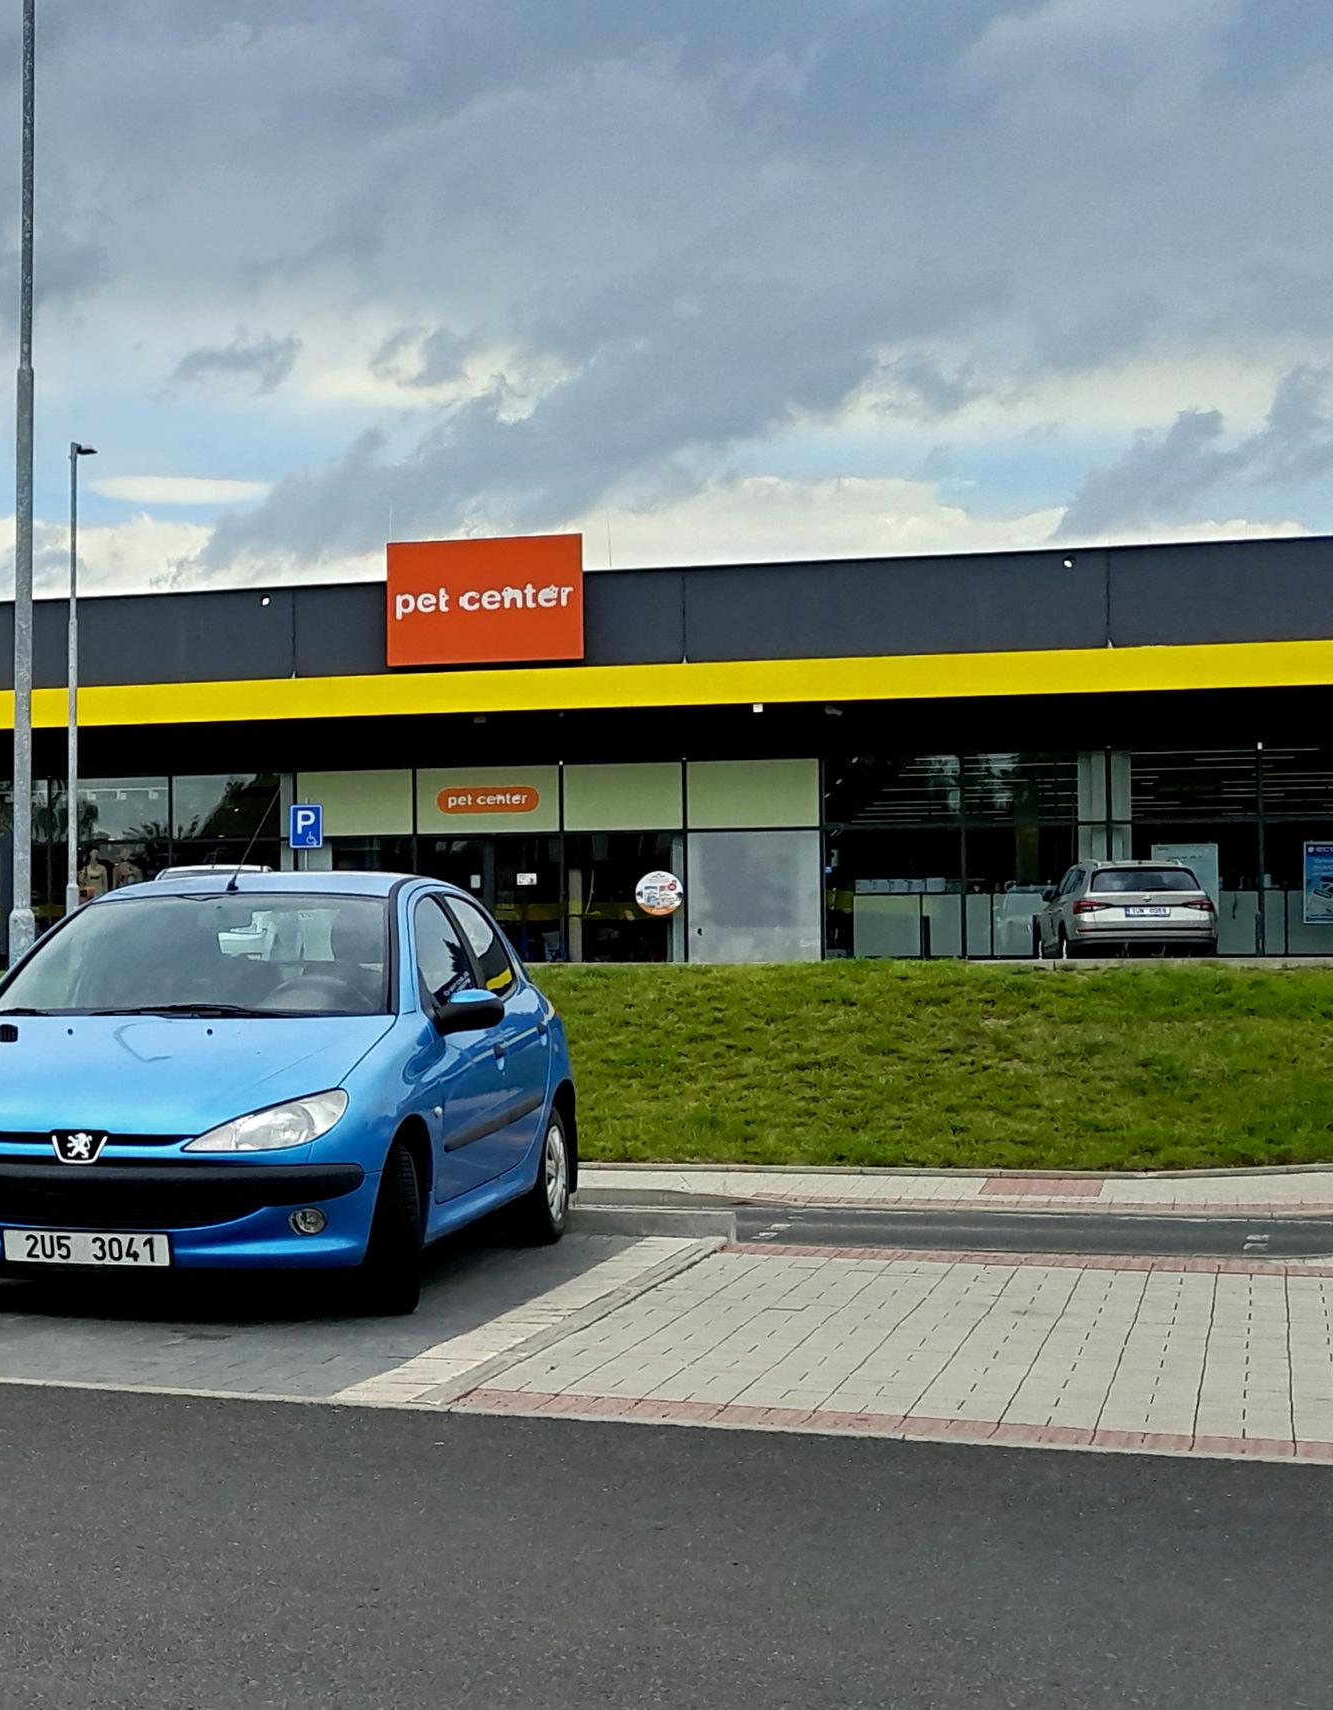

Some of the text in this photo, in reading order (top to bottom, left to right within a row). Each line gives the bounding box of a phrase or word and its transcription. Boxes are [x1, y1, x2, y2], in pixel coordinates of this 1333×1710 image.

[395, 583, 574, 620] pet center
[447, 793, 528, 809] pet center
[297, 810, 316, 834] P
[25, 1234, 155, 1263] 2U5 3041
